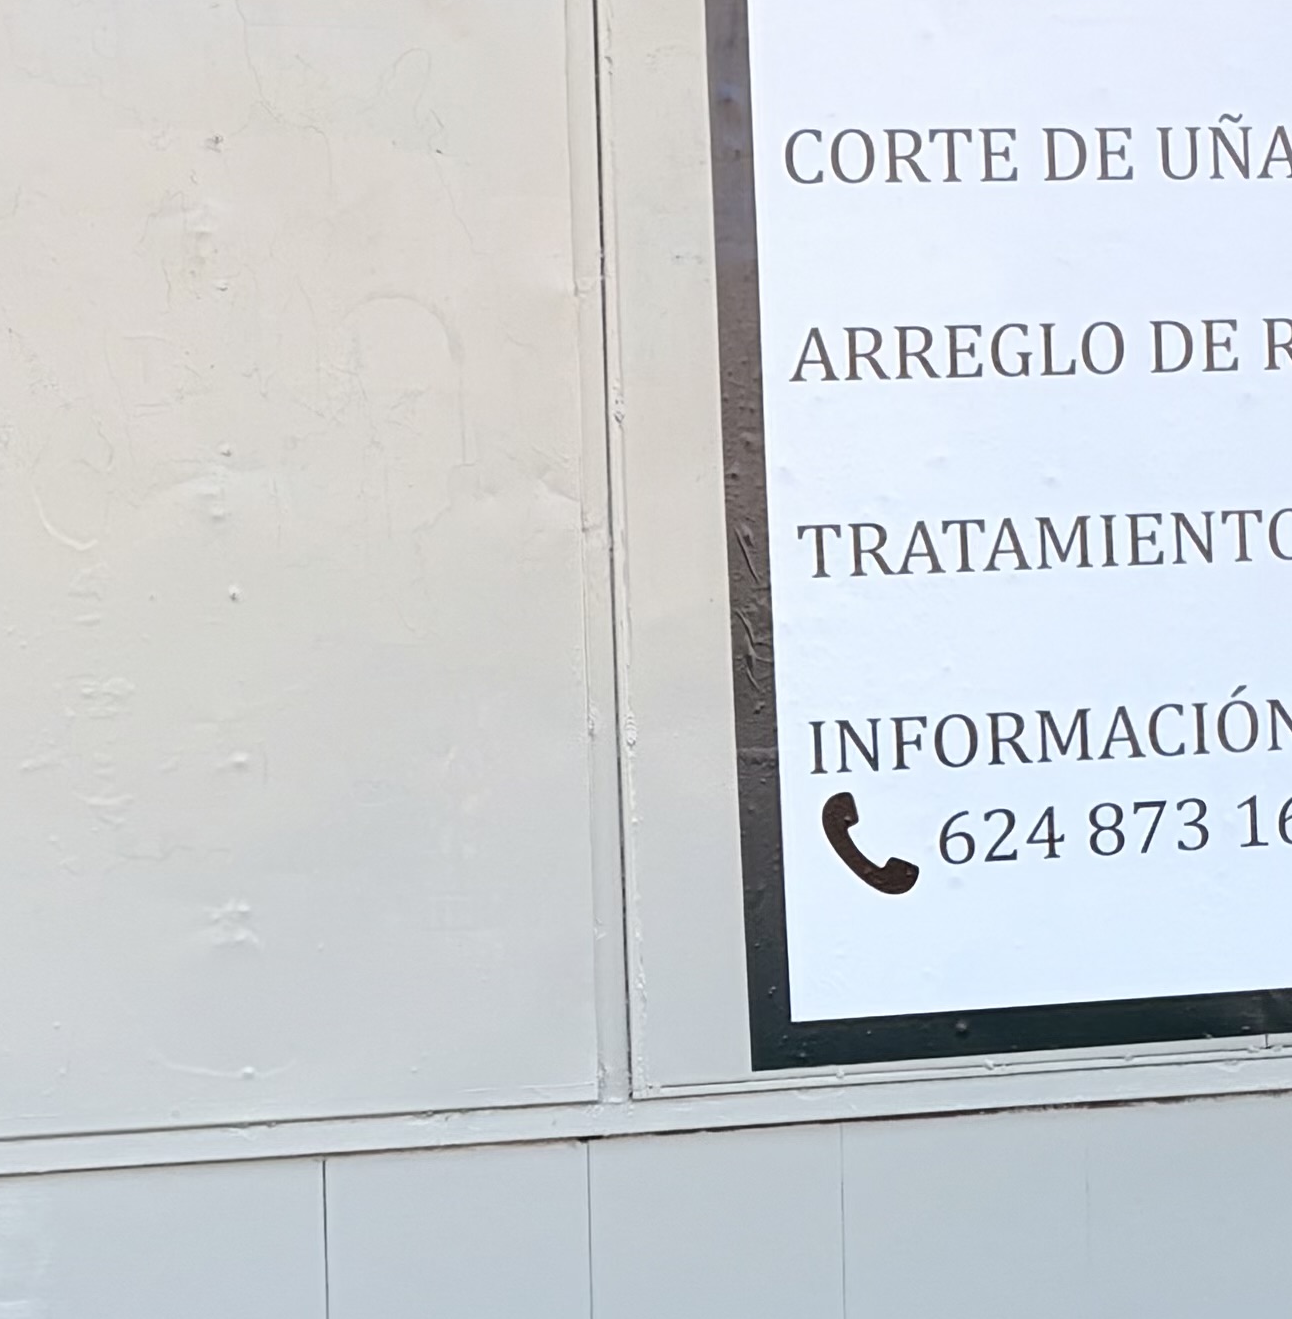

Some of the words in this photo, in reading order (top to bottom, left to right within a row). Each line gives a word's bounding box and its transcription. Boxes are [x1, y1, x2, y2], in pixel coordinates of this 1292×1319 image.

[784, 128, 1019, 185] CORTE
[1042, 127, 1134, 182] DE
[789, 321, 1126, 382] ARREGLO
[1149, 319, 1239, 374] DE
[938, 805, 1066, 865] 624
[1087, 797, 1210, 857] 873
